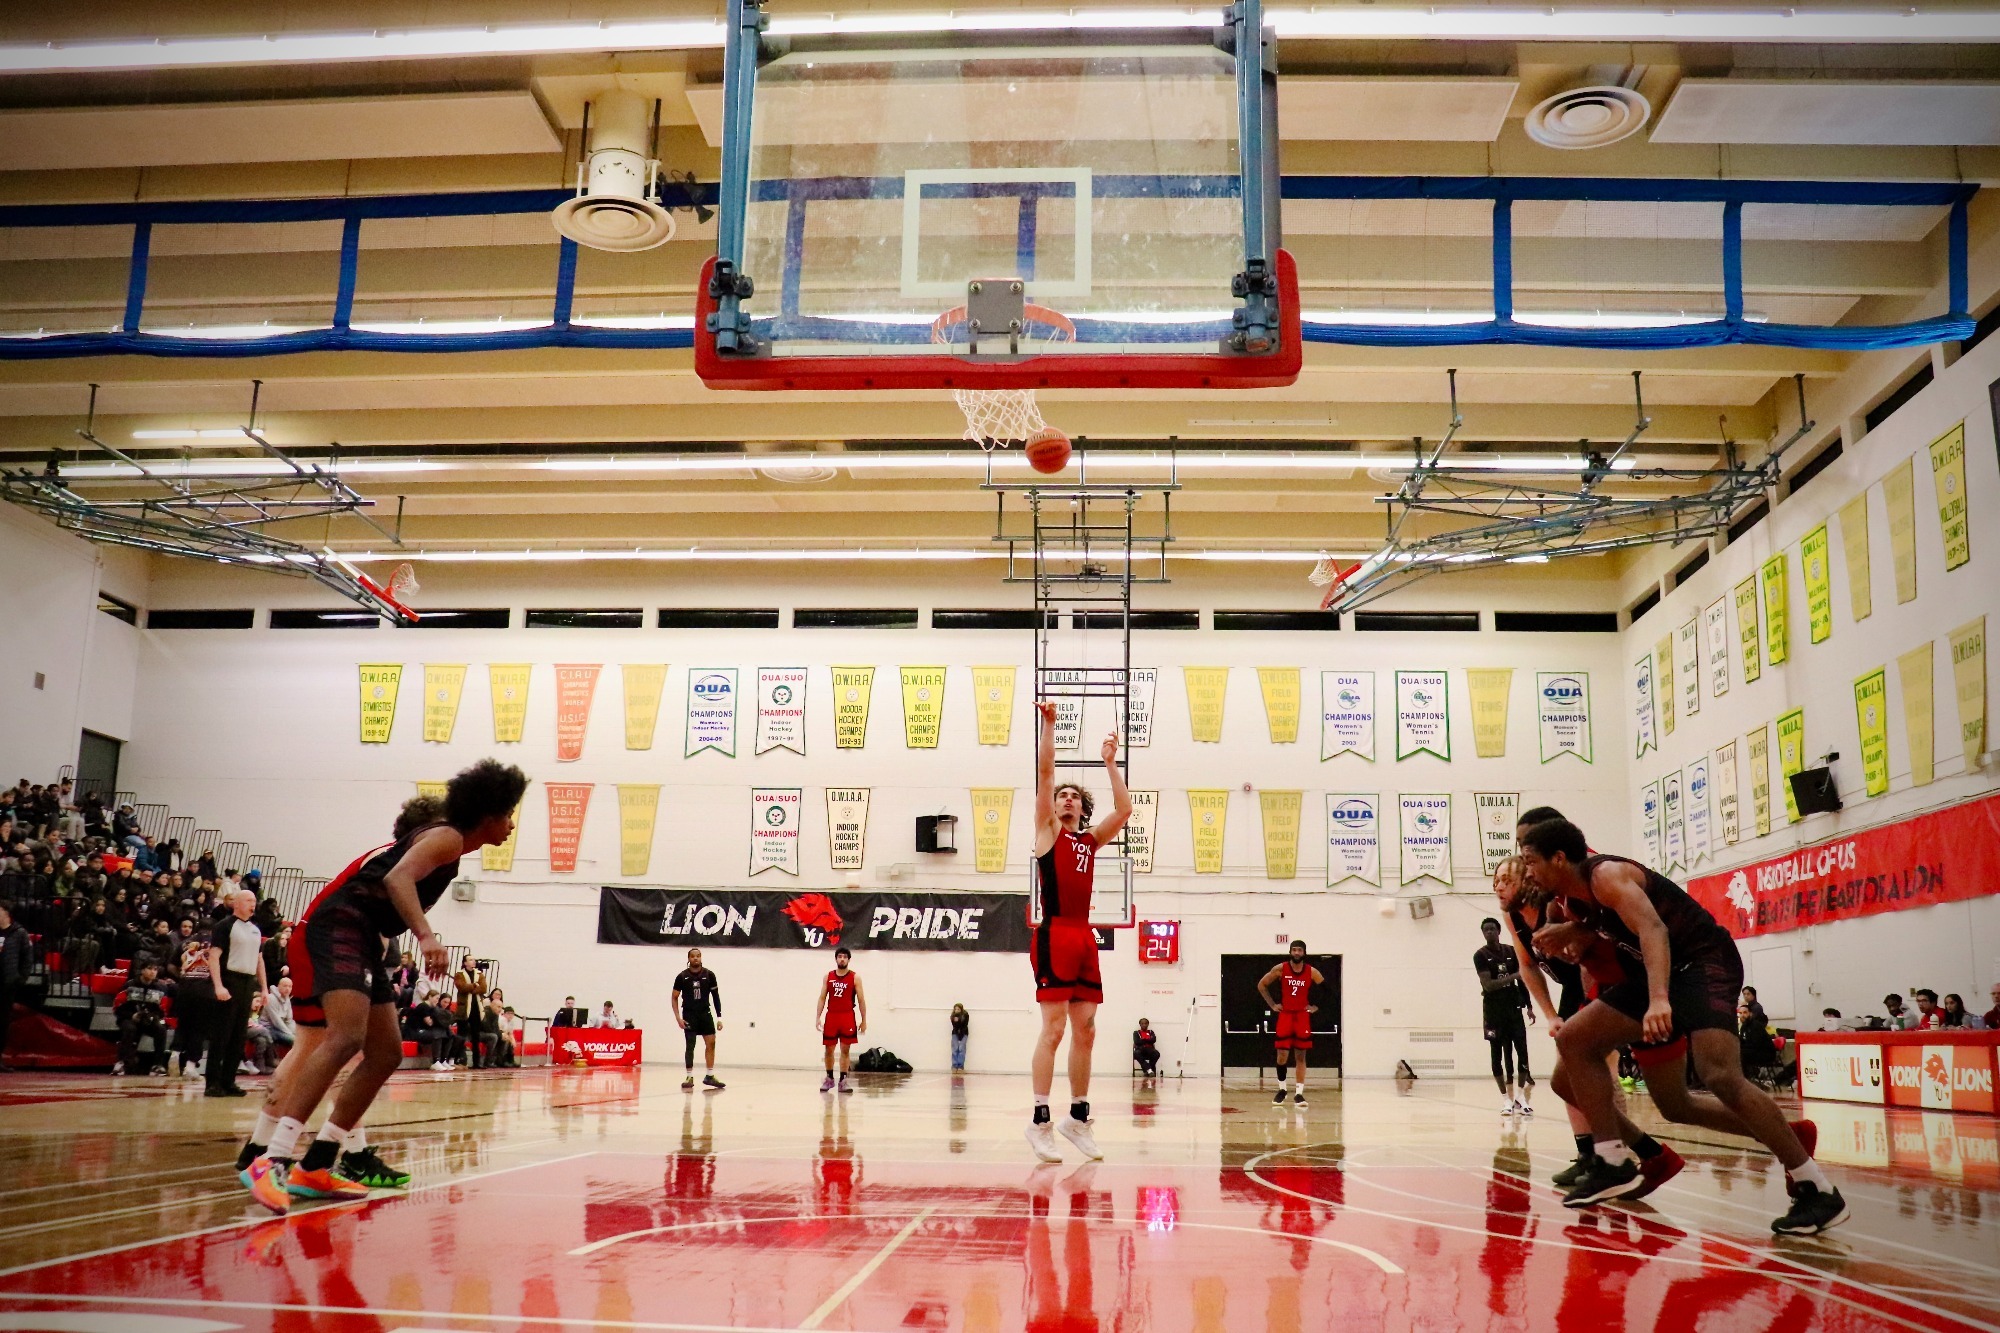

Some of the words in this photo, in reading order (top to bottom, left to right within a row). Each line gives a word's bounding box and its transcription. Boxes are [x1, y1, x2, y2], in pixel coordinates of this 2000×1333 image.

[1337, 677, 1359, 685] OUA
[693, 683, 732, 694] OUA
[1543, 687, 1583, 697] OUA
[980, 702, 1007, 711] HOCKEY
[690, 710, 733, 718] CHAMPIONS
[759, 709, 803, 717] CHAMPIONS
[1055, 713, 1079, 721] OCKEY
[1325, 713, 1372, 721] CHAMPIONS
[1400, 712, 1445, 720] CHAMPIONS
[364, 716, 389, 726] CHAMPS
[838, 715, 864, 725] HOCKEY
[908, 714, 937, 723] HOCKEY
[1541, 714, 1587, 723] CHAMPIONS
[839, 726, 863, 736] CHAMPS
[909, 725, 937, 735] CHAMPS
[982, 724, 1006, 733] CHAMPS
[1053, 723, 1077, 731] HAMPS
[755, 794, 798, 802] OUA/SUO
[1332, 809, 1375, 819] OUA
[1272, 815, 1292, 826] FIELD
[836, 823, 859, 831] INDOOR
[1199, 827, 1218, 836] FIELD
[753, 830, 798, 838] CHAMPIONS
[835, 832, 859, 841] HOCKEY
[1268, 831, 1295, 842] HOCKEY
[1486, 831, 1511, 840] TENNIS
[978, 837, 1004, 846] HOCKEY
[1196, 838, 1220, 847] HOCKEY
[1330, 837, 1377, 845] CHAMPIONS
[1403, 836, 1449, 844] CHAMPIONS
[834, 842, 860, 851] CHAMPS
[1071, 841, 1092, 856] YOK
[979, 848, 1004, 858] CHAMPS
[1197, 849, 1220, 859] CHAMPS
[1486, 848, 1512, 857] CHAMPS
[1075, 854, 1089, 874] 21
[1790, 854, 1815, 883] ALL
[1837, 841, 1857, 871] US
[1887, 872, 1901, 901] A
[659, 903, 757, 937] LION
[868, 907, 984, 940] PRIDE
[802, 926, 825, 949] YU
[1146, 938, 1171, 959] 24
[832, 980, 849, 990] YORK
[1287, 979, 1306, 987] YORK
[833, 988, 844, 998] 22
[1291, 986, 1298, 996] 2
[583, 1042, 610, 1052] YORK
[609, 1041, 637, 1053] LIONS
[1824, 1056, 1850, 1073] YORK
[1888, 1065, 1921, 1088] YORK
[1953, 1066, 1994, 1094] LIONS
